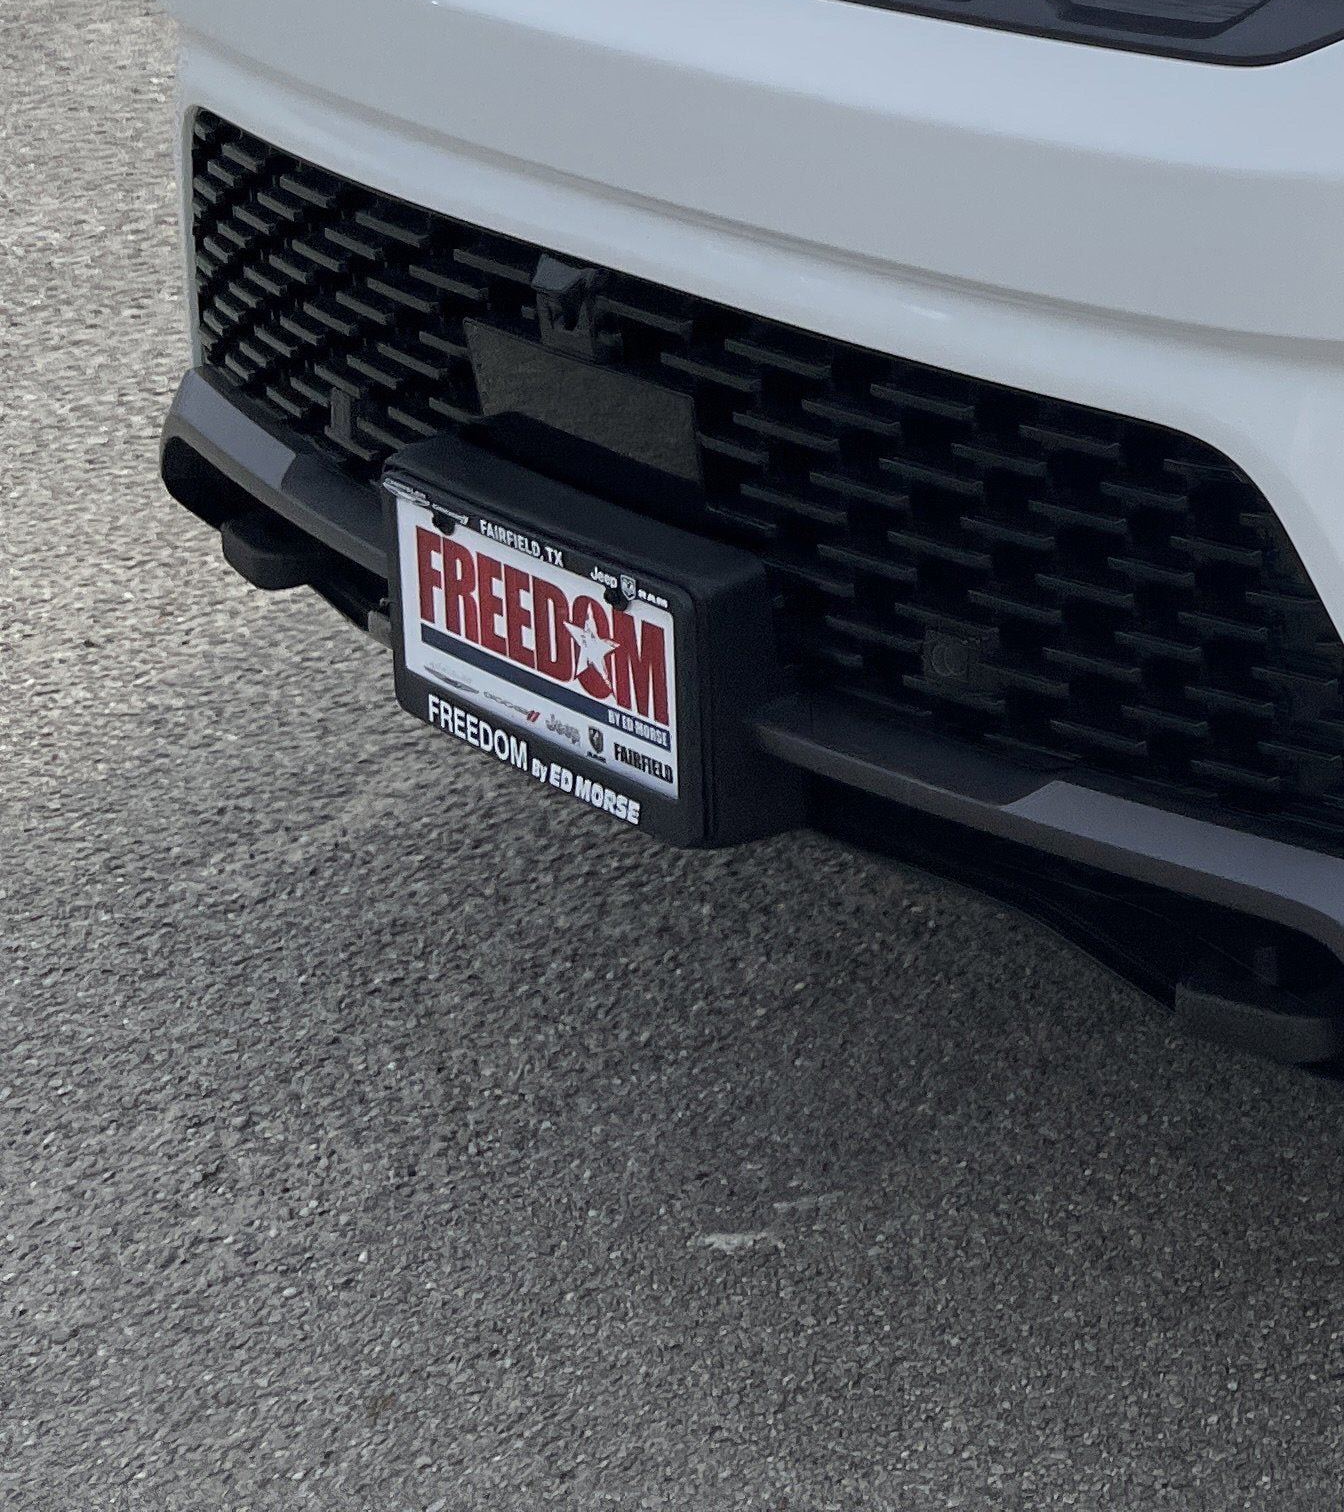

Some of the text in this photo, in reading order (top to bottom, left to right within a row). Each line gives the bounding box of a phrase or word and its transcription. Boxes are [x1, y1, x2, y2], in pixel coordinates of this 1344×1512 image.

[544, 545, 564, 568] TX
[415, 524, 671, 728] FREEDOM
[428, 693, 528, 772] FREEDOM
[549, 762, 573, 793] ED
[574, 774, 641, 825] MORSE
[613, 741, 674, 785] FAIRFIELD
